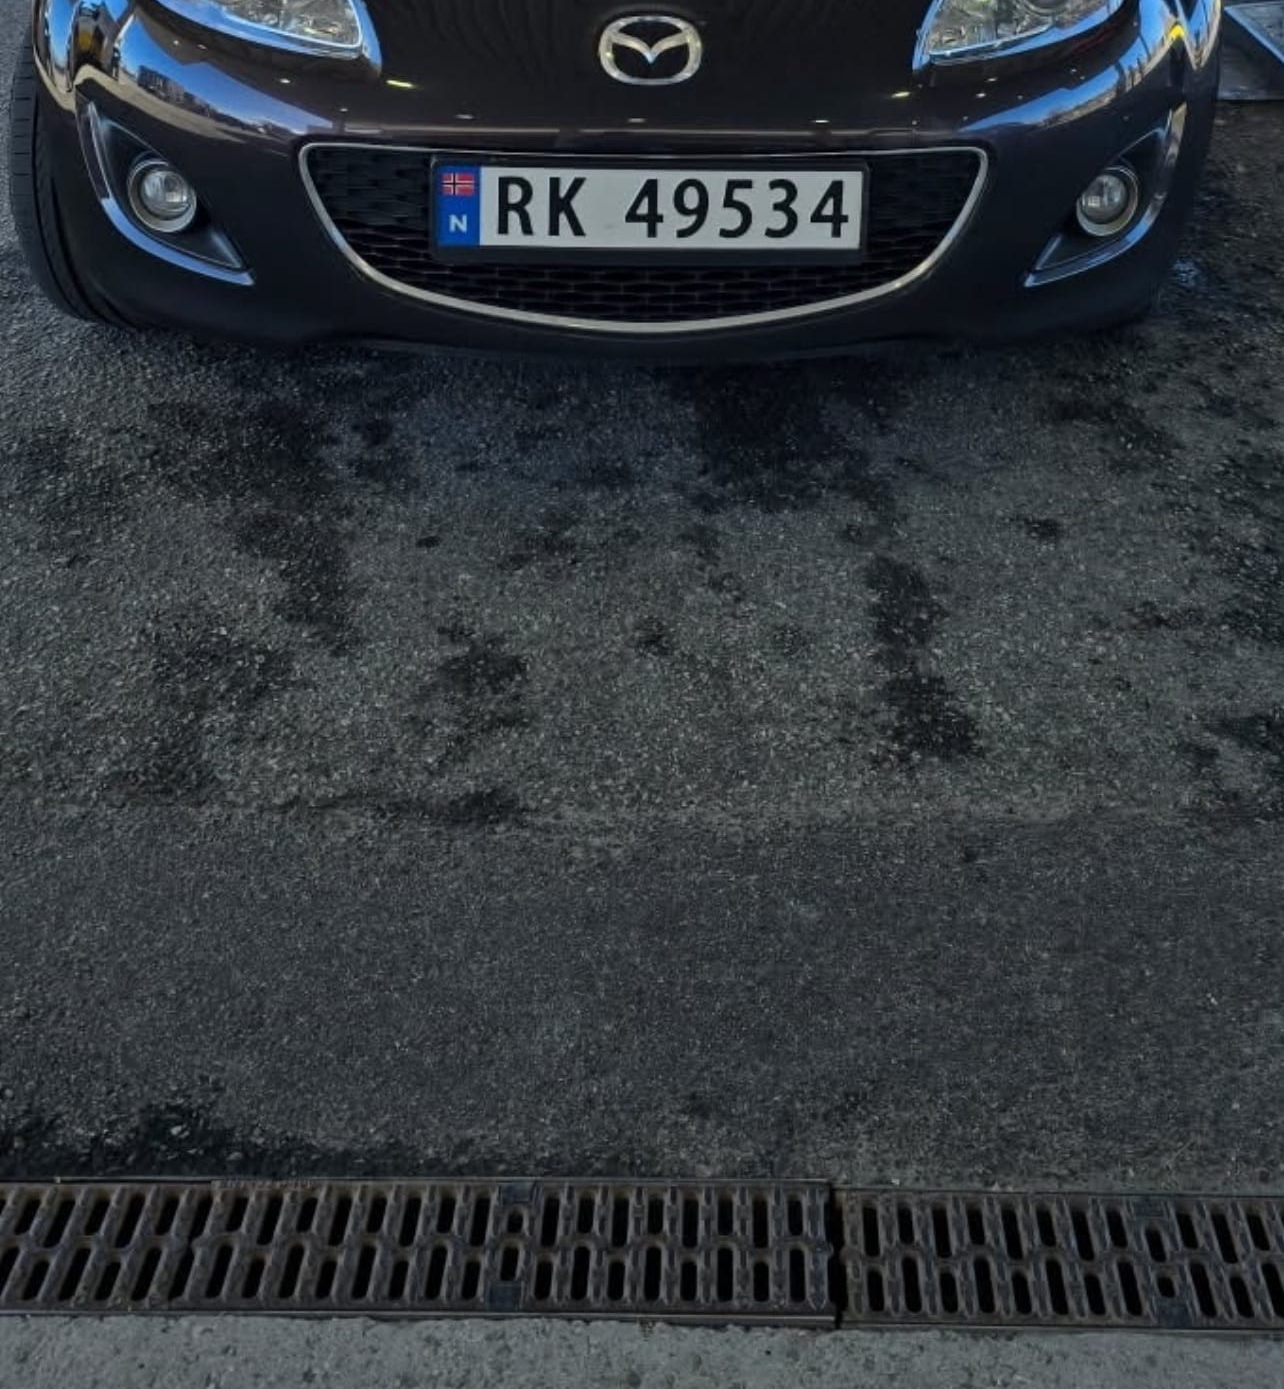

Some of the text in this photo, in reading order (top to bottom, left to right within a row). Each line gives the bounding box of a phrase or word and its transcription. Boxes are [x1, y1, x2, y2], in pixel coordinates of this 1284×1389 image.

[449, 215, 468, 232] N
[497, 176, 849, 239] RK 49534
